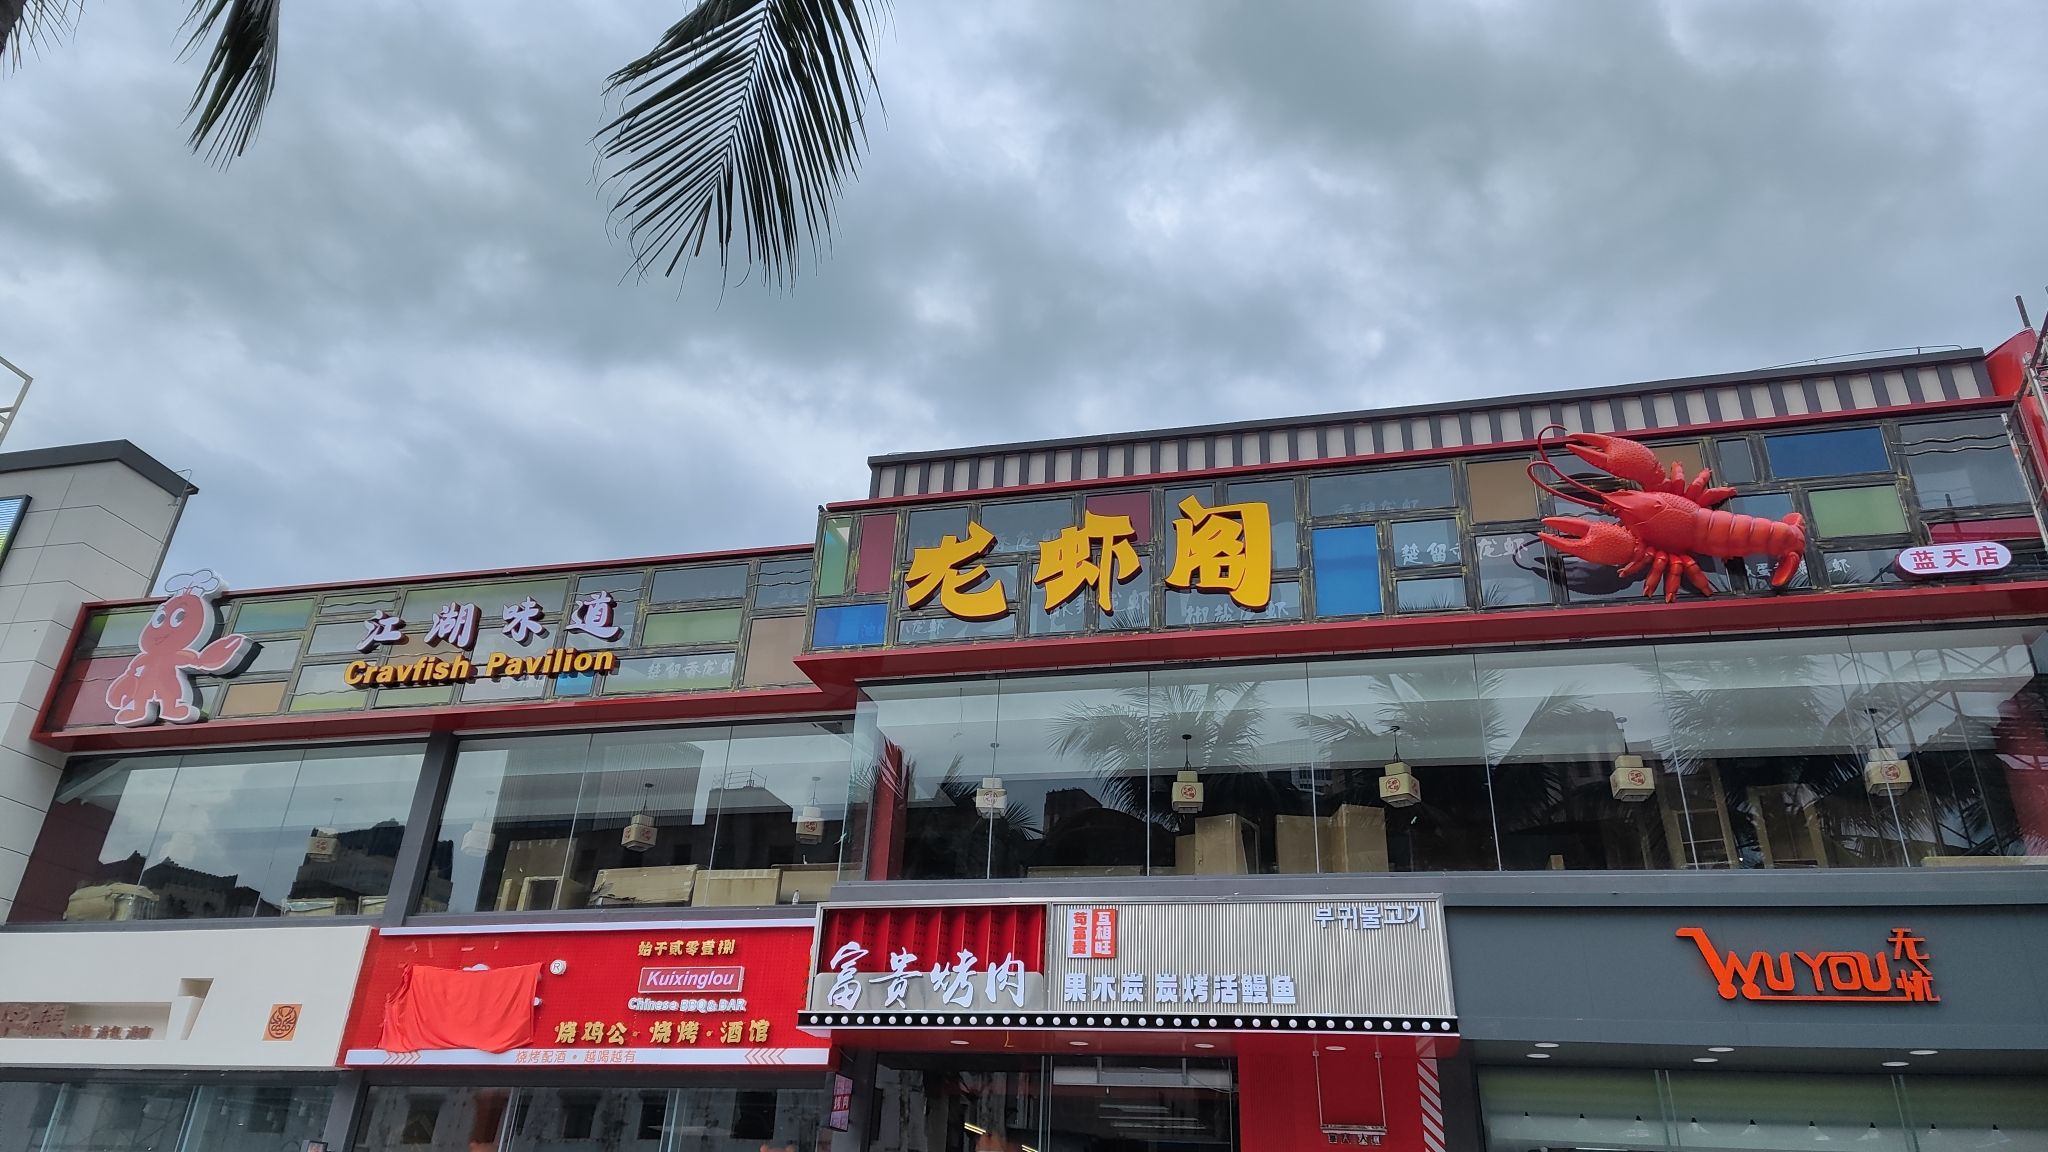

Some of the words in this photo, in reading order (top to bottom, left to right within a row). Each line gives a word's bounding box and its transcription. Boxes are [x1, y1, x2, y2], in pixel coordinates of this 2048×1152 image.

[1910, 546, 2001, 571] 蓝天店
[356, 590, 619, 651] 江湖味道
[486, 648, 614, 676] Pavilion
[1313, 905, 1426, 930] 부귀불고기
[1072, 911, 1088, 955] 苟富贵
[1095, 911, 1112, 955] 互相旺
[646, 970, 734, 989] Kuixinglou
[827, 940, 1025, 1011] 富贵烤肉
[1064, 972, 1145, 1003] 果木炭
[1154, 973, 1297, 1005] 炭烤活鳗鱼
[628, 997, 679, 1012] Chinese
